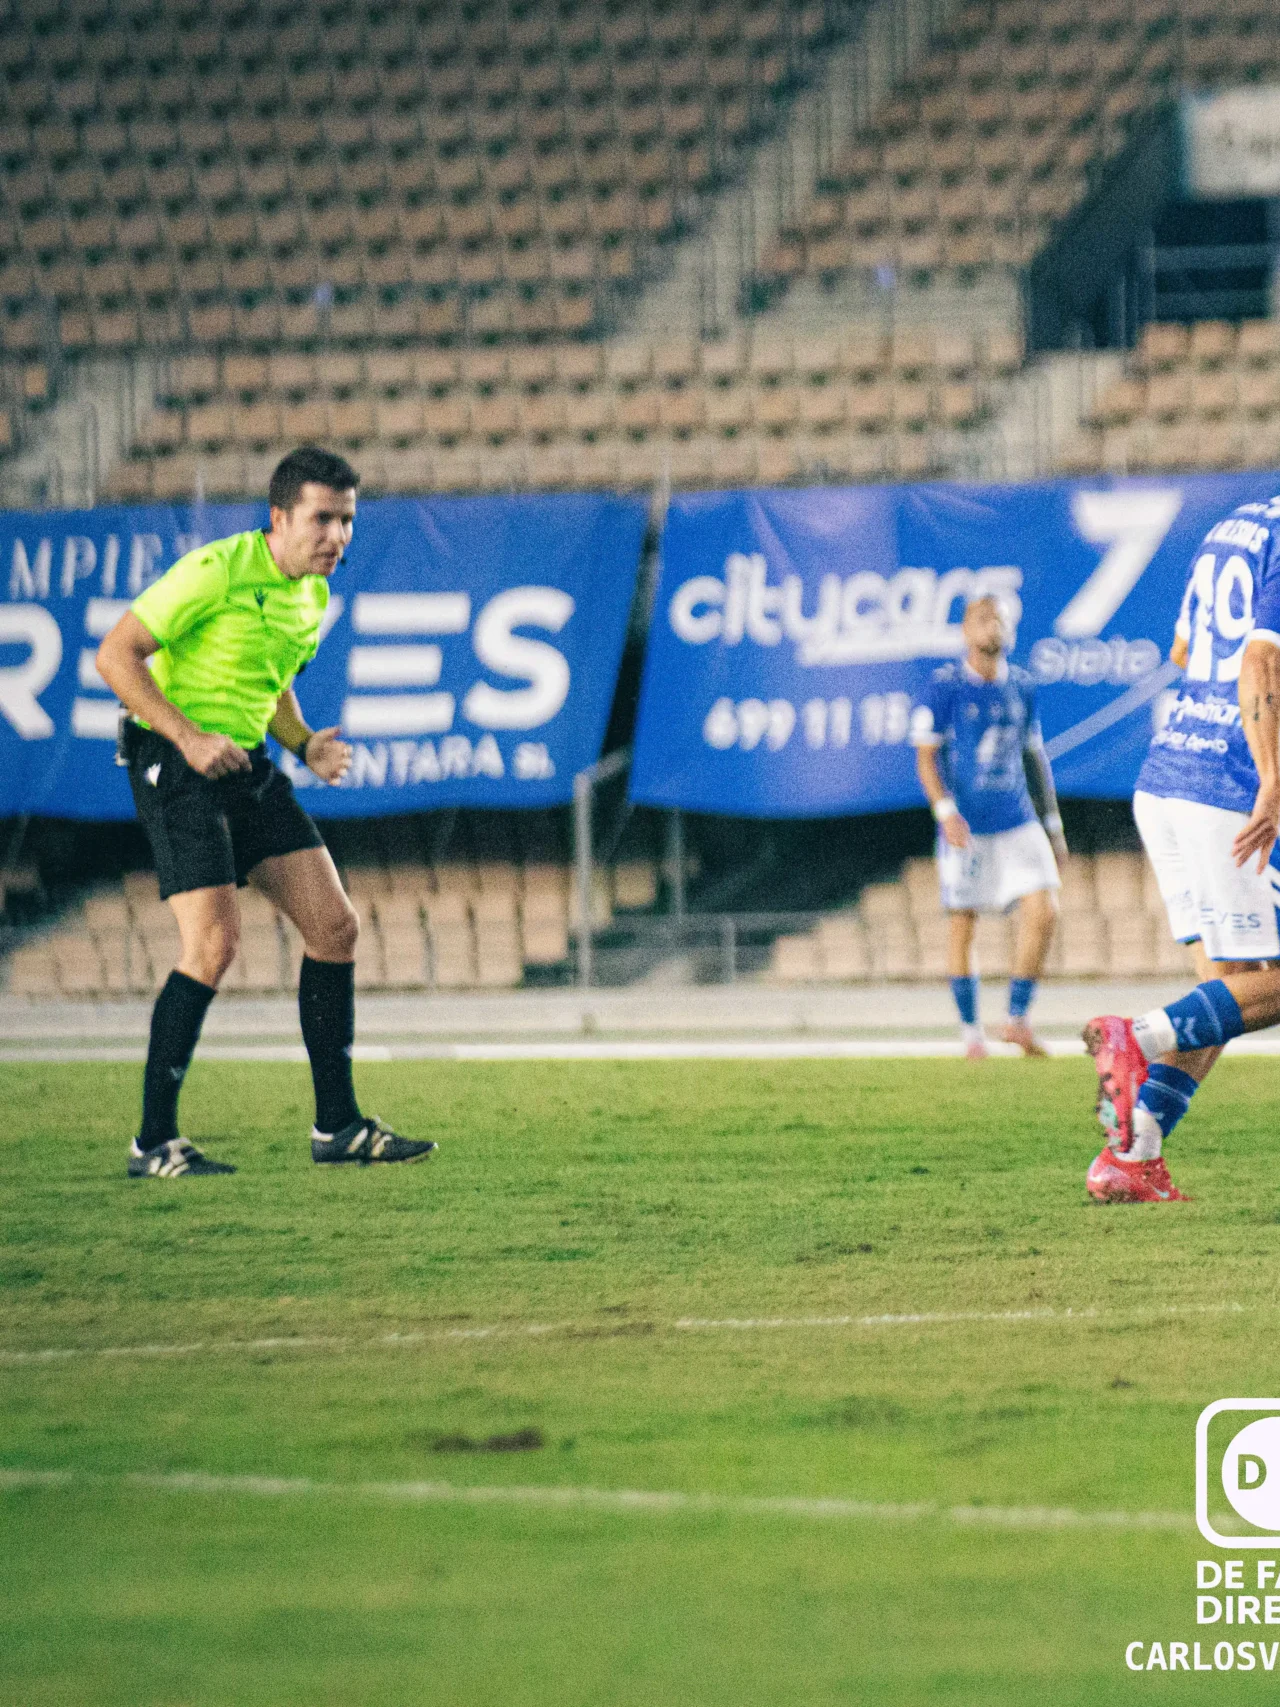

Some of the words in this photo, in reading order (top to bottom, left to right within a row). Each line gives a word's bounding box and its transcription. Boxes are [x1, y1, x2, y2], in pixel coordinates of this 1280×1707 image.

[8, 532, 200, 599] MPIE
[1056, 490, 1186, 638] 7
[0, 588, 576, 740] RES
